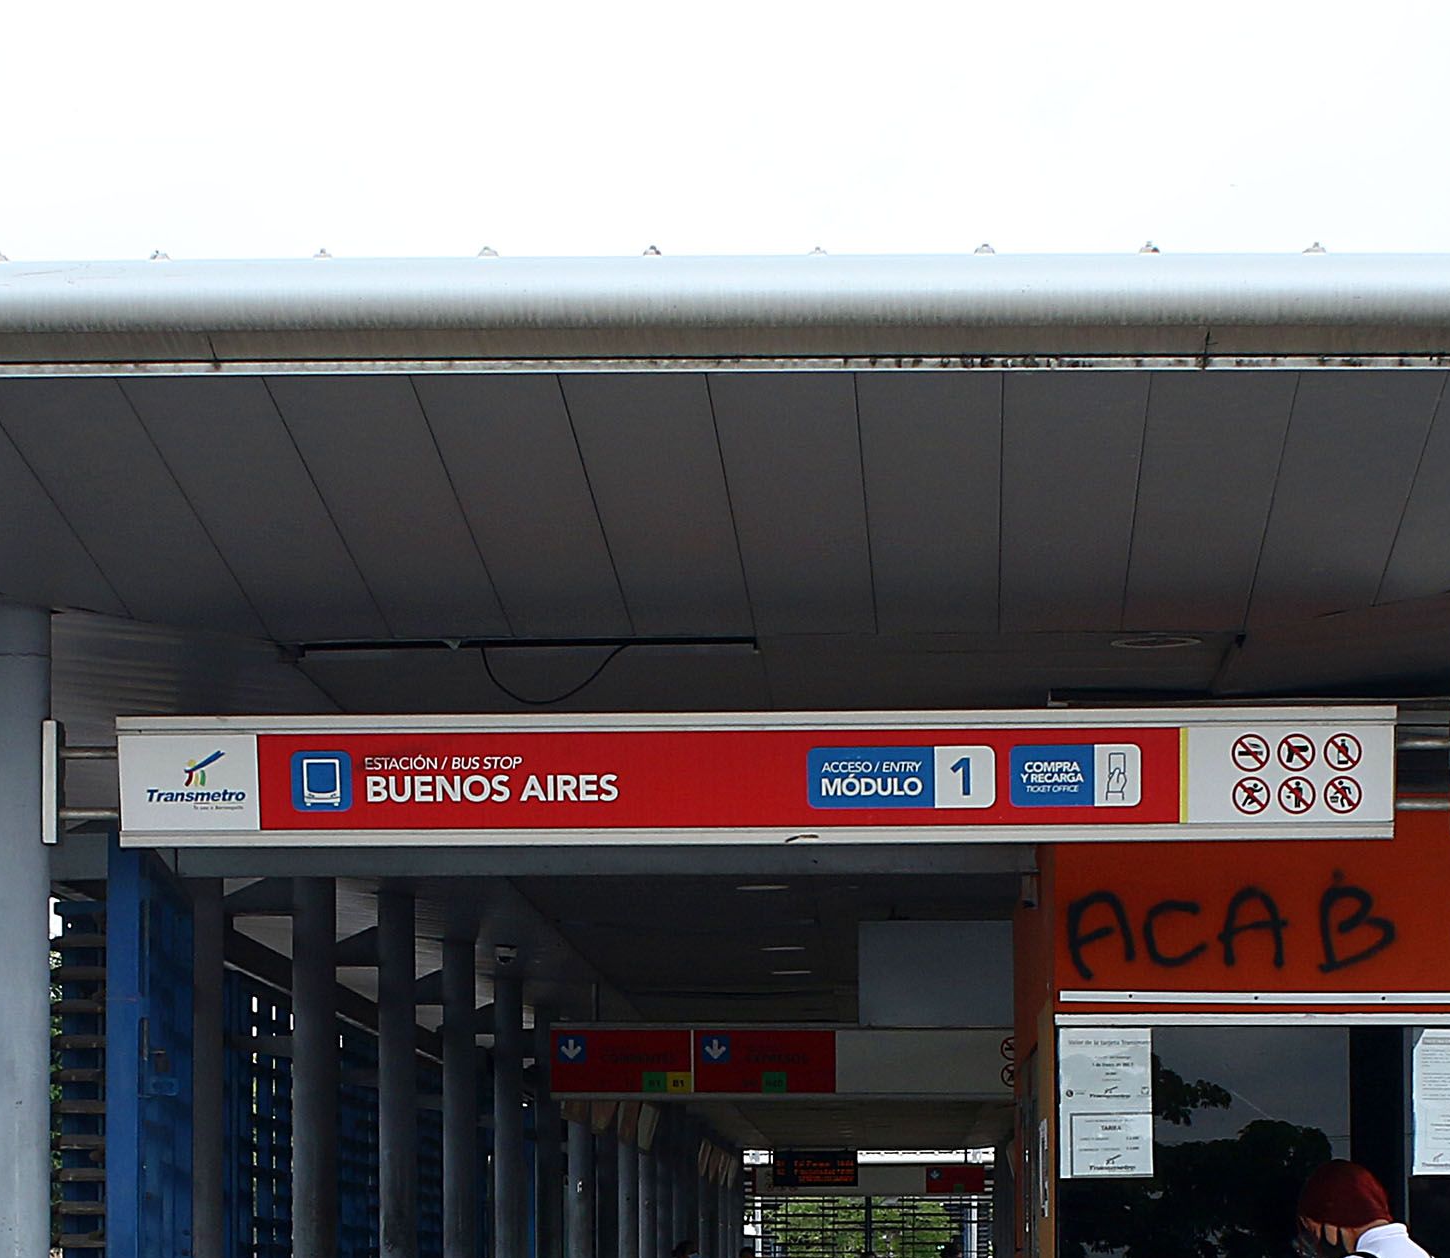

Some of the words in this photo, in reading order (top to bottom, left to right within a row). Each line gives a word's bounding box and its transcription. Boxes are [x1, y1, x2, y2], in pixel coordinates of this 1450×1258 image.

[364, 754, 438, 770] ESTACIÓN
[451, 756, 480, 770] BUS
[483, 756, 523, 770] STOP
[821, 760, 872, 773] ACCESO
[882, 760, 923, 773] ENTRY
[1023, 761, 1080, 773] COMPRA
[949, 756, 971, 796] 1
[1020, 773, 1030, 784] Y
[1030, 772, 1084, 783] RECARGA
[366, 774, 511, 802] BUENOS
[520, 774, 619, 802] AIRES
[821, 773, 923, 797] MÓDULO
[1025, 785, 1051, 793] TICKET
[1052, 784, 1079, 793] OFFICE
[146, 789, 246, 803] Transmetro
[1066, 881, 1397, 981] ACAB
